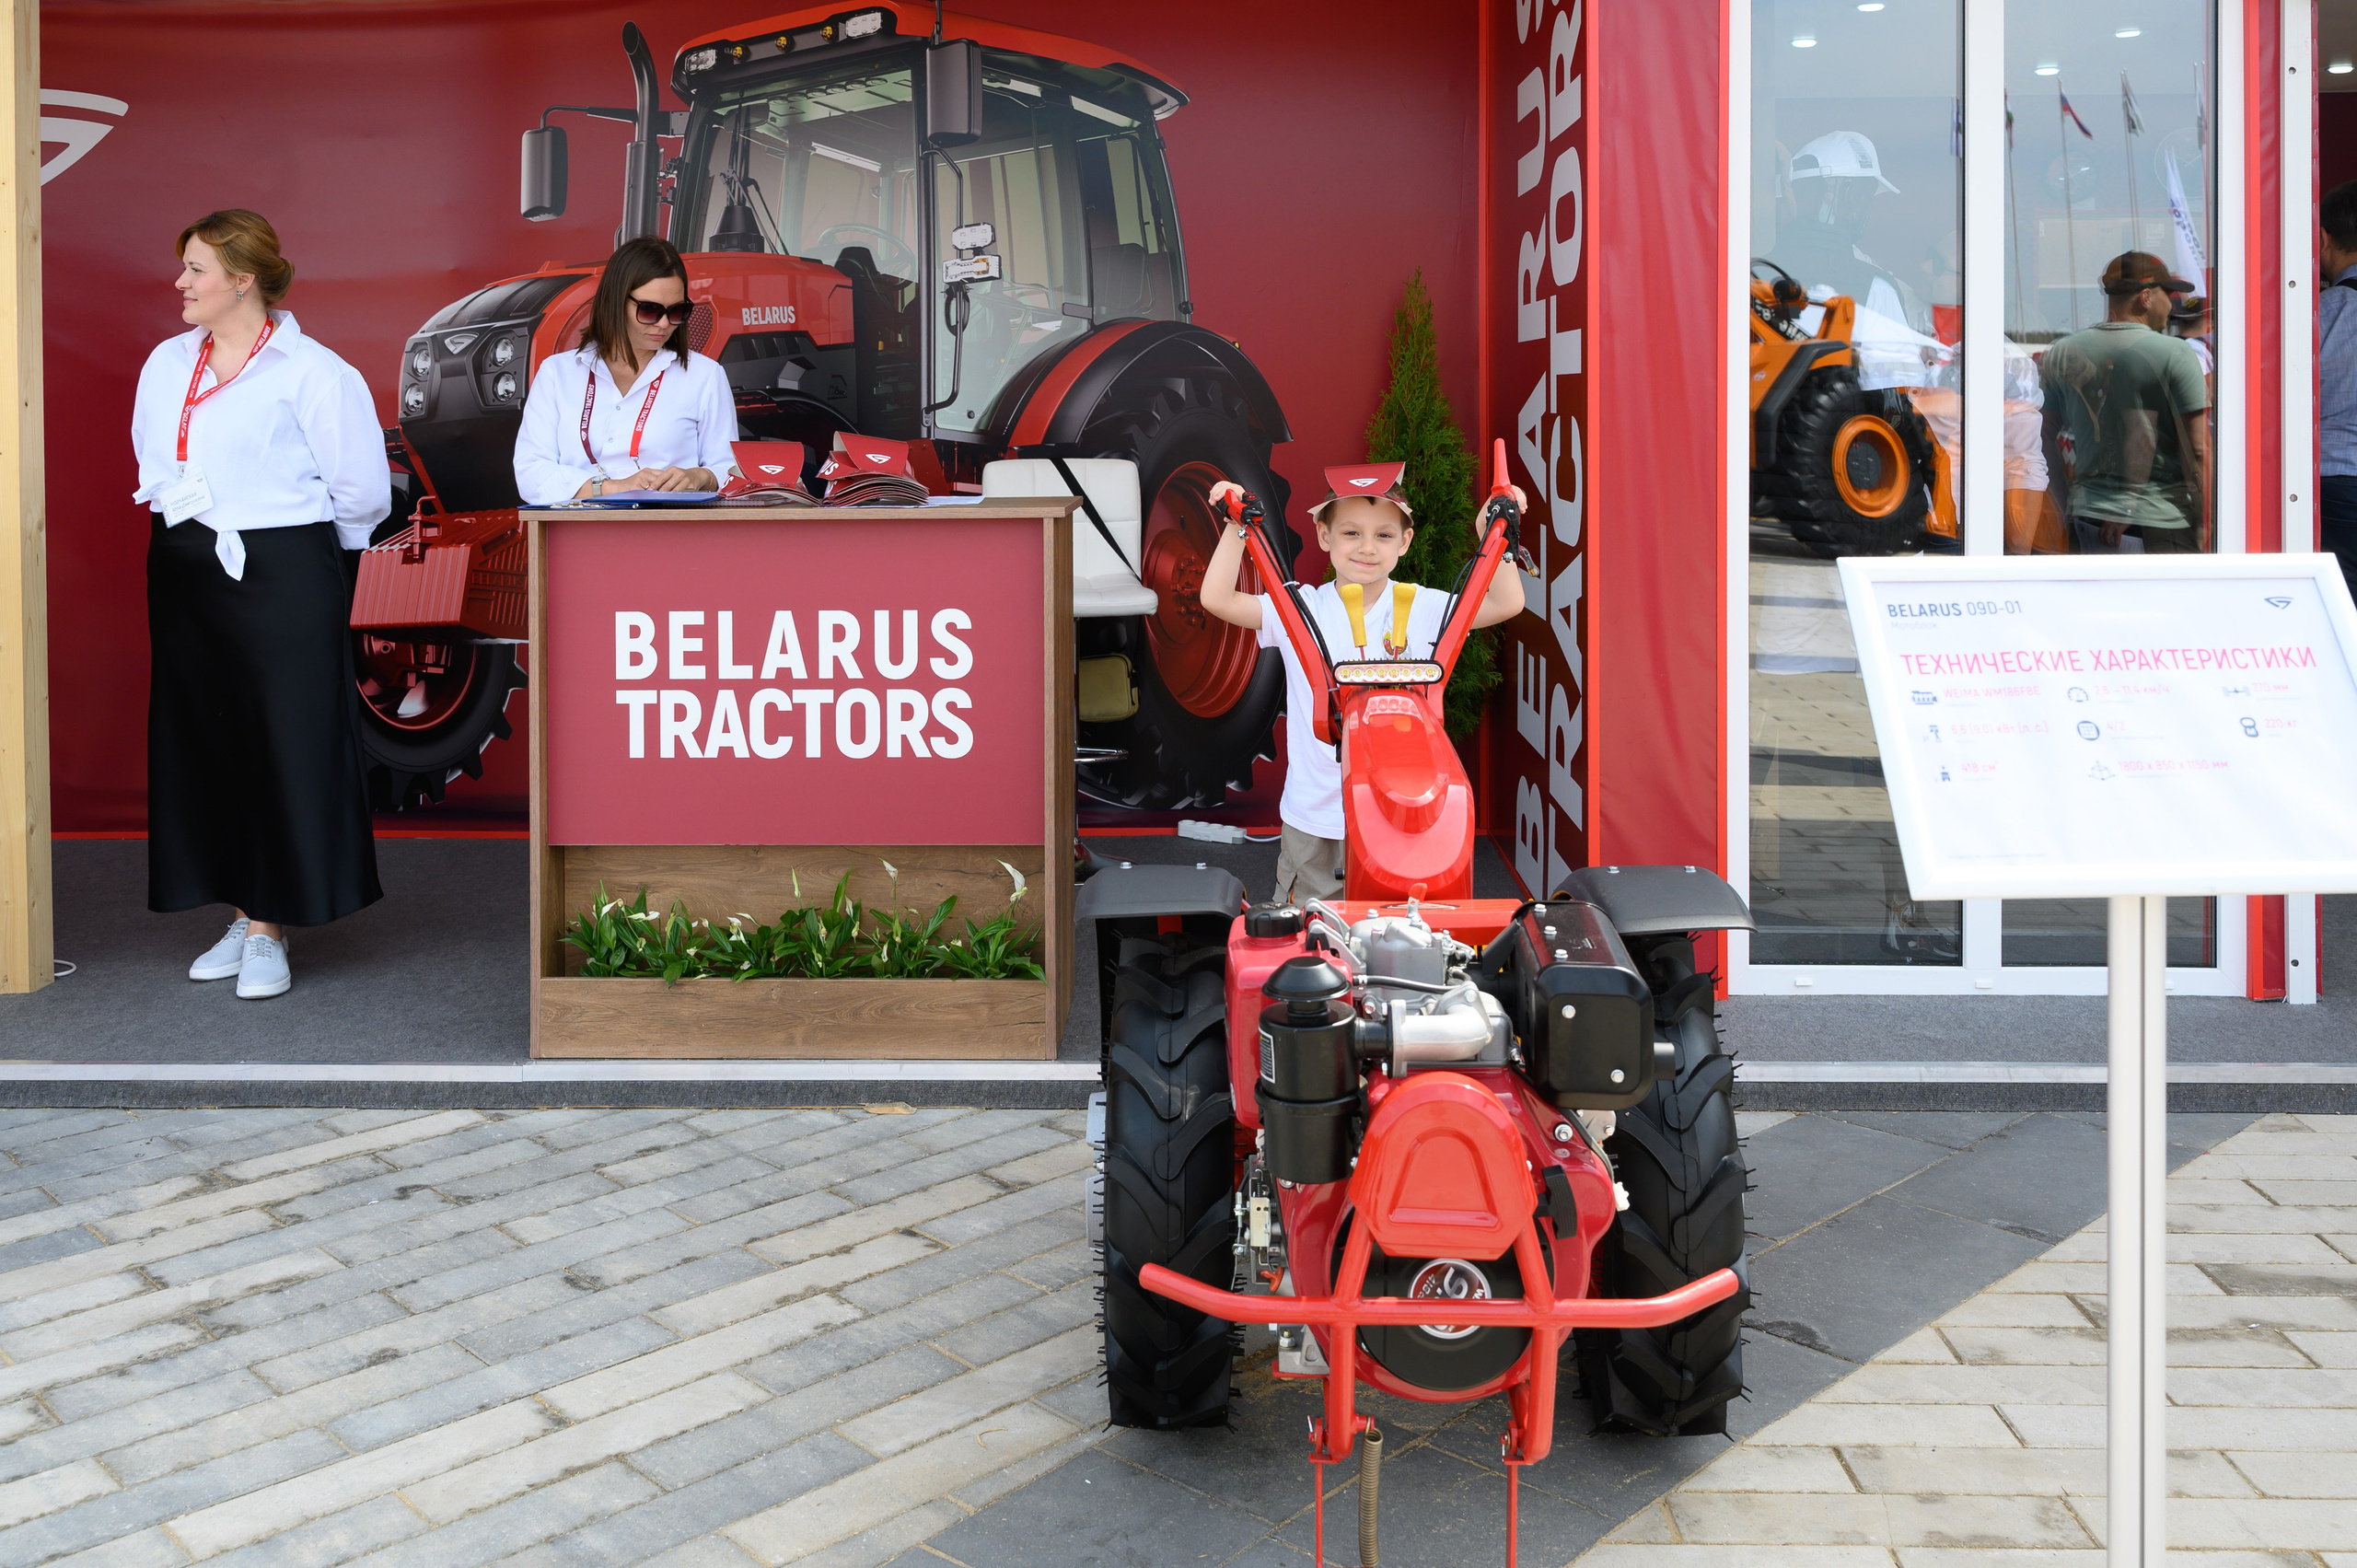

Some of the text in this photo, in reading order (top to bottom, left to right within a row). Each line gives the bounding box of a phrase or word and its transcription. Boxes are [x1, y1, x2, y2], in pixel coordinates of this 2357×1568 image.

[741, 306, 796, 326] BELARUS
[258, 325, 272, 348] BELARUS
[581, 383, 595, 429] BELARUS TRACTORS
[635, 389, 656, 432] BELARUS TRACTORS
[1548, 0, 1583, 900] TRACTOR
[1887, 600, 2023, 618] BELARUS 09D-01
[615, 608, 974, 680] BELARUS
[1899, 646, 2317, 676] ТЕХНИЧЕСКИЕ ХАРАКТЕРИСТИКИ
[1944, 688, 1980, 699] WEIMA
[615, 687, 974, 760] TRACTORS
[2212, 761, 2229, 769] мм
